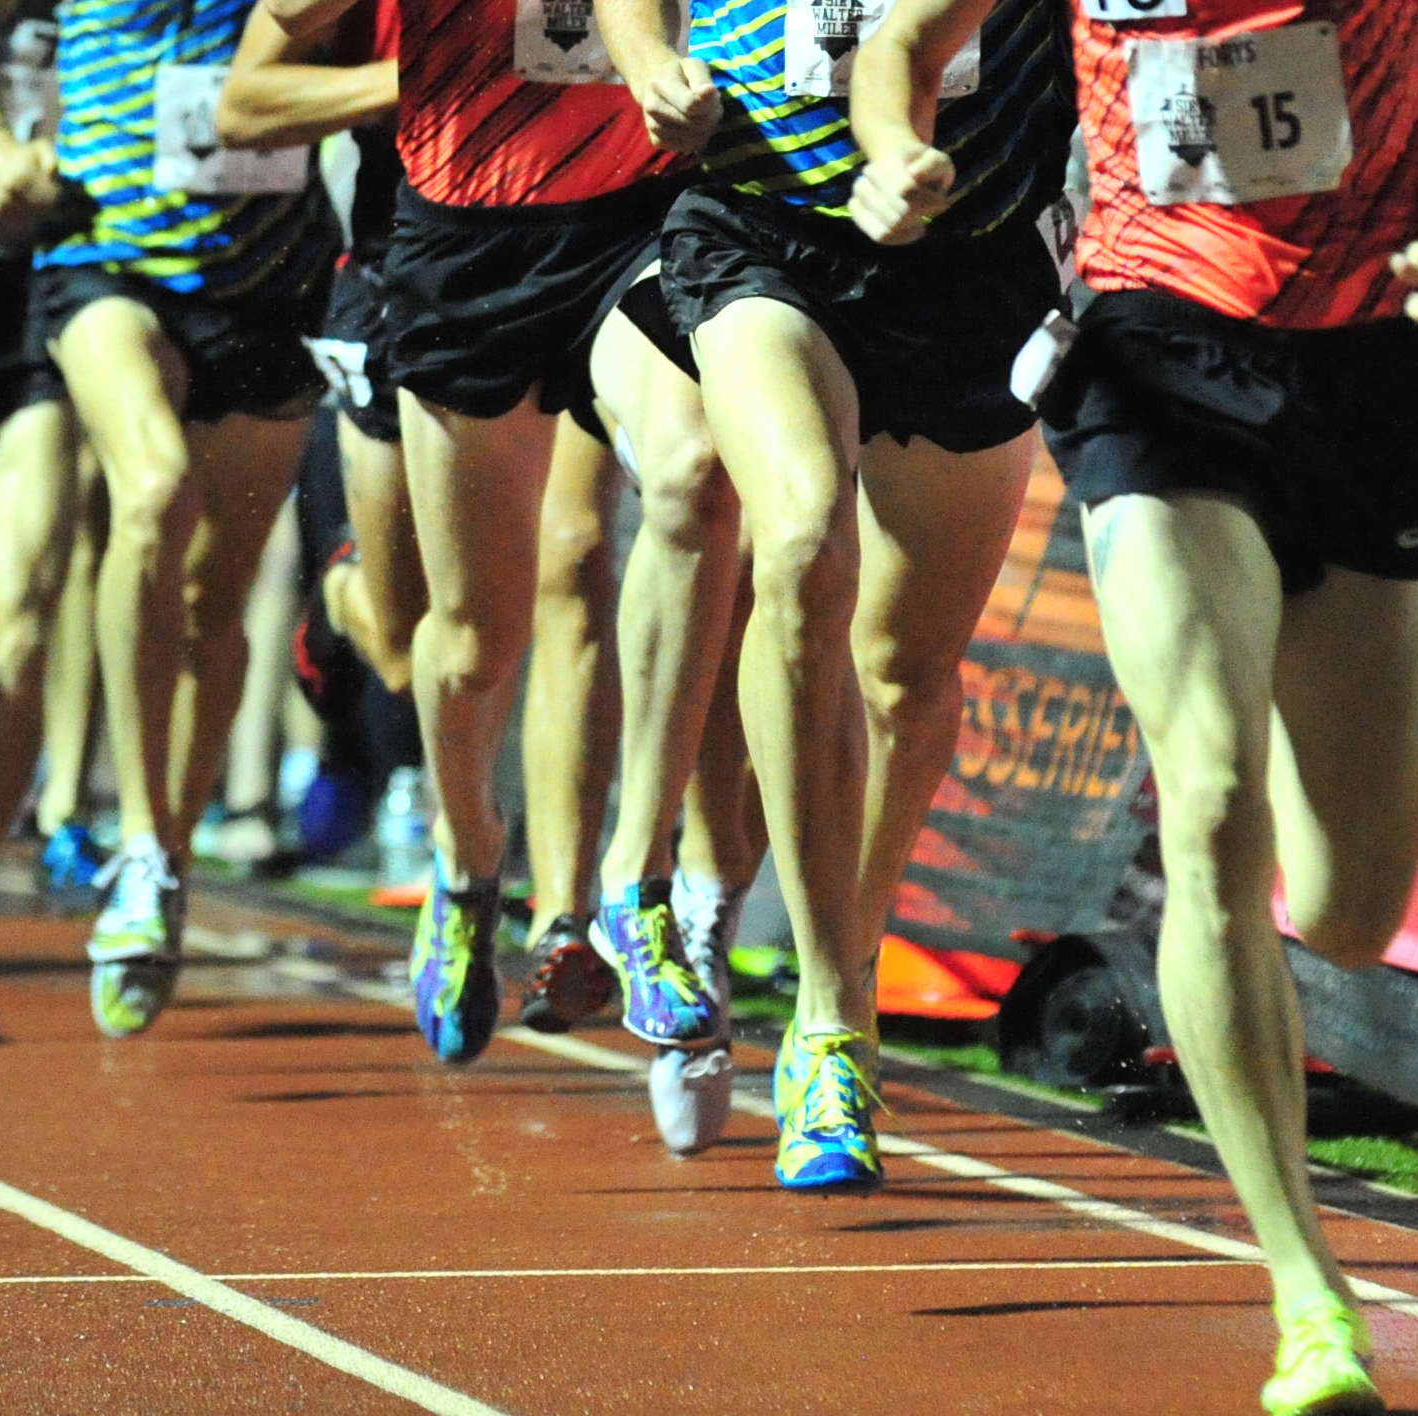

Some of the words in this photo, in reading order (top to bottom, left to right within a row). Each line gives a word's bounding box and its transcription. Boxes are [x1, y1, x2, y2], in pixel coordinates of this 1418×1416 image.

[812, 8, 863, 22] WALTER
[817, 22, 858, 35] MILER
[1250, 91, 1302, 151] 15
